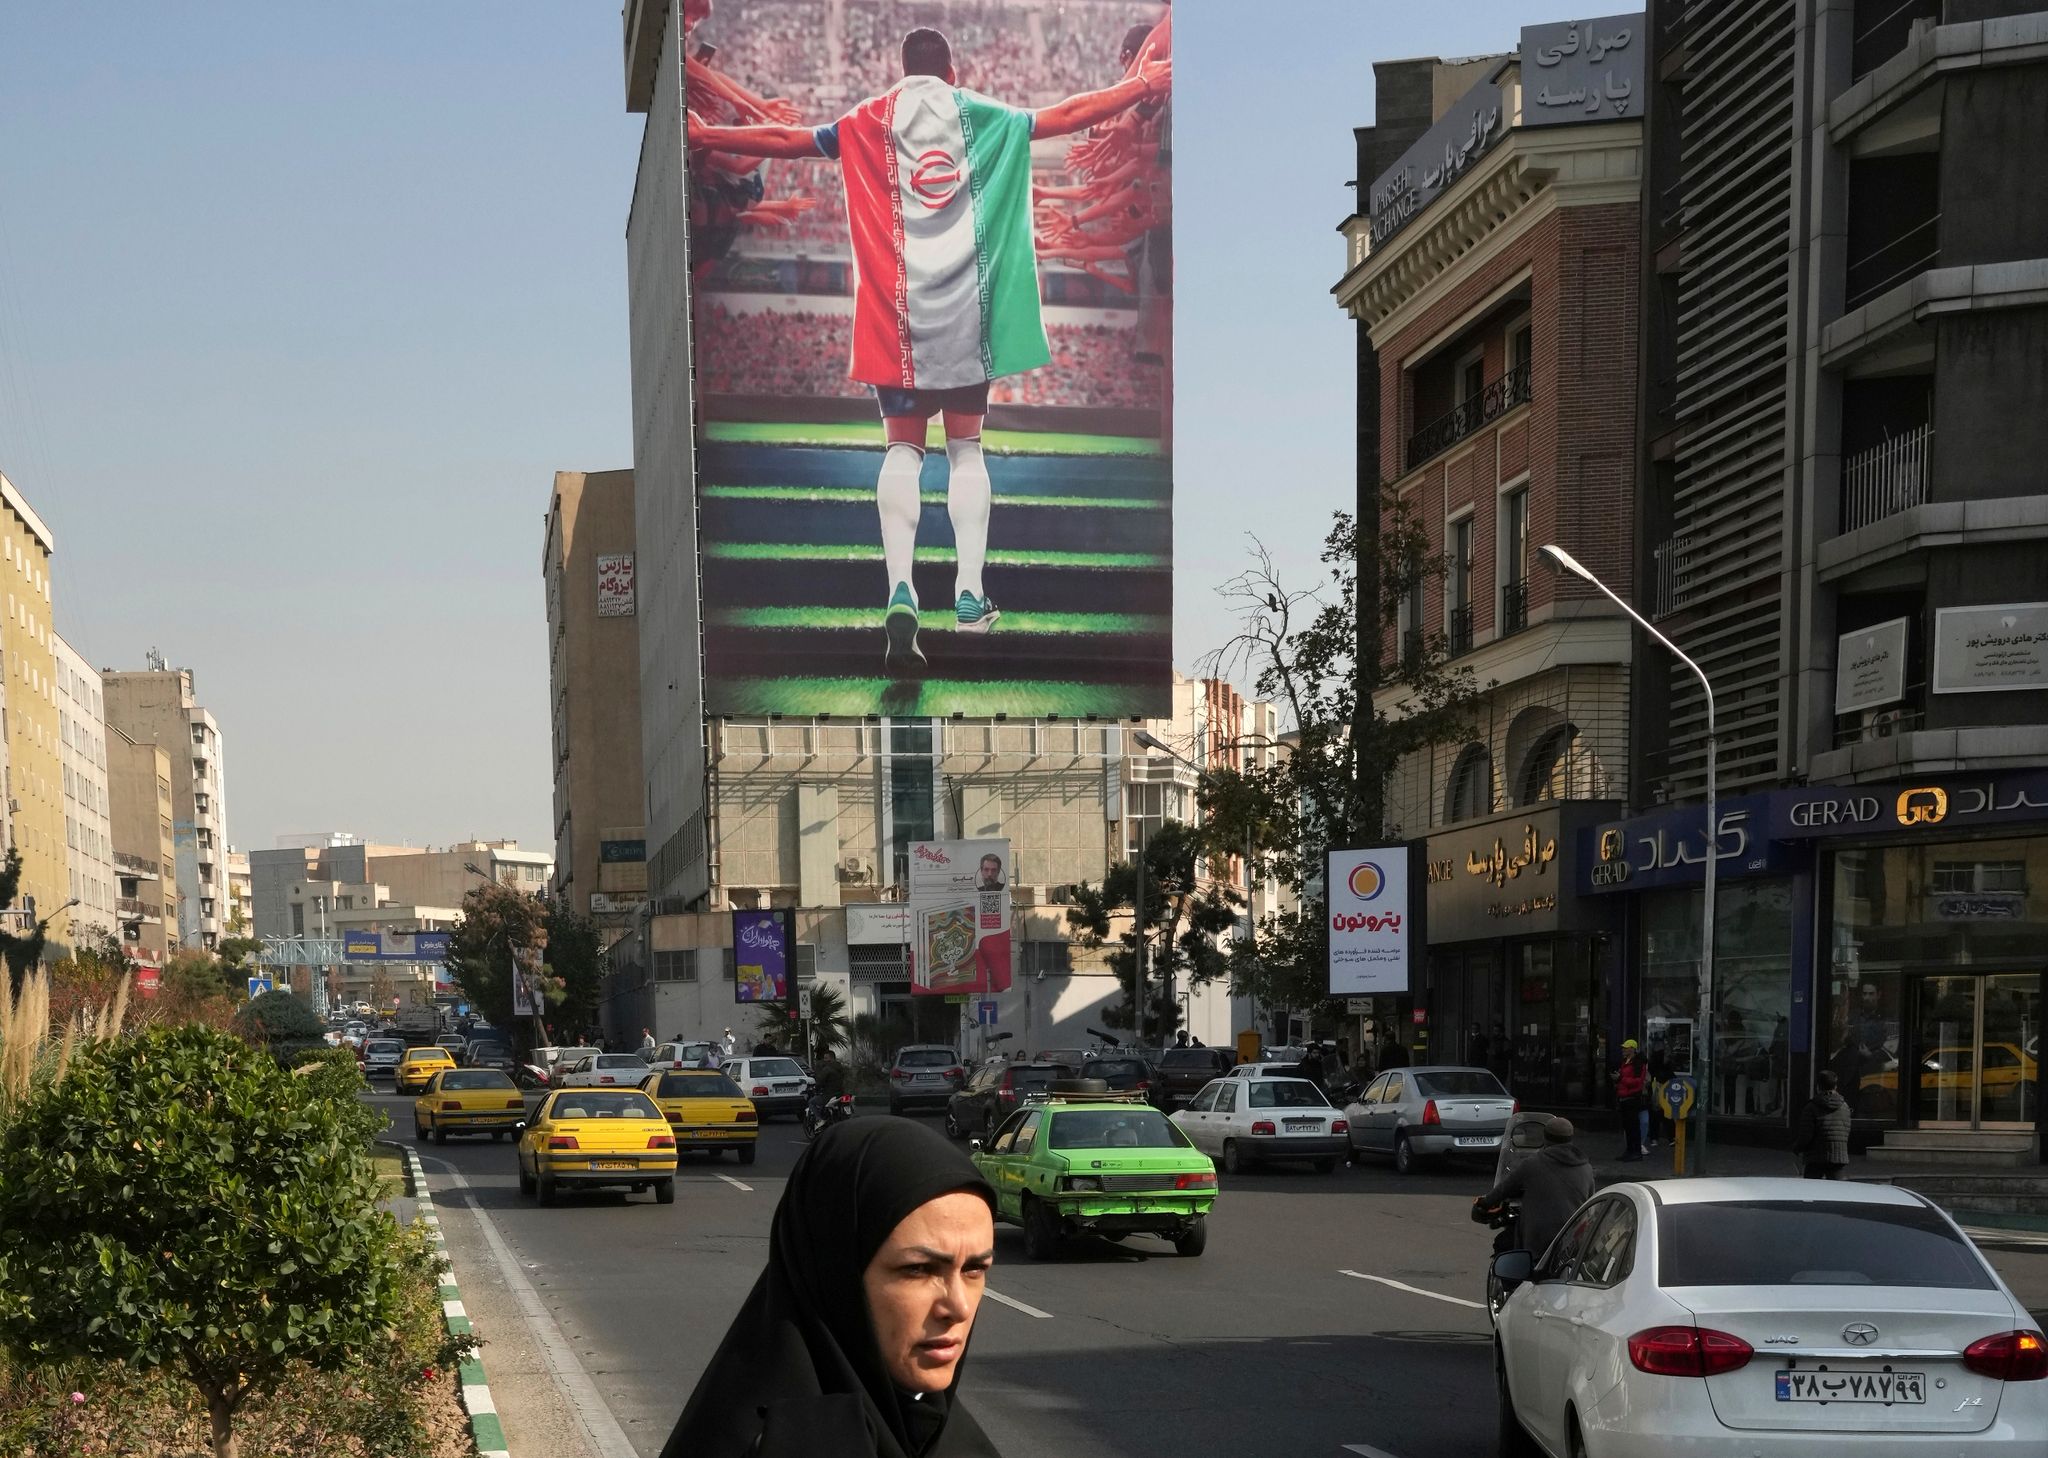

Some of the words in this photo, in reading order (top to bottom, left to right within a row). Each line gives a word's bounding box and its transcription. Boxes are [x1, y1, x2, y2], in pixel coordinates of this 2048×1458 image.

[1536, 22, 1632, 67] صرافی
[1536, 70, 1632, 115] پارسه
[1455, 106, 1497, 170] صرافی
[1375, 166, 1408, 215] PARSEH
[598, 555, 632, 575] پارس
[599, 576, 633, 596] ایزوگام
[1965, 639, 1980, 649] پور
[1980, 633, 2010, 647] درویش
[2011, 634, 2032, 645] هادی
[1958, 782, 2048, 815] راد
[1789, 797, 1879, 826] GERAD
[1466, 837, 1504, 888] پارسه
[1506, 824, 1556, 879] صرافی
[1591, 861, 1628, 886] GERAD
[1333, 911, 1401, 935] پترونون
[1764, 1335, 1800, 1345] JAC
[1895, 1381, 1922, 1400] ۹۹
